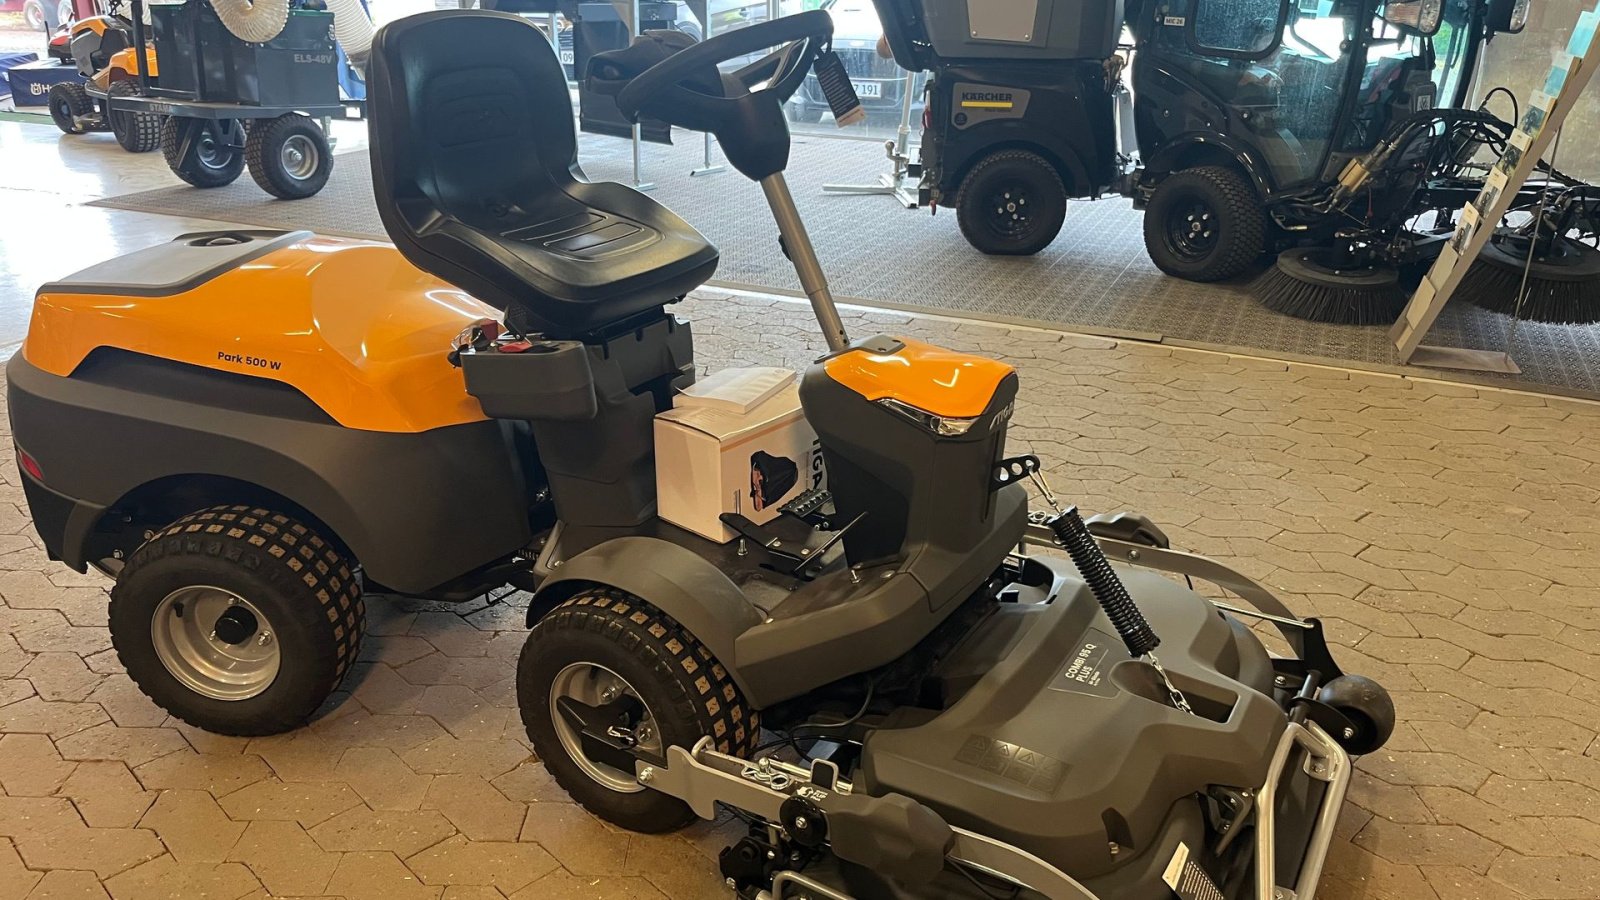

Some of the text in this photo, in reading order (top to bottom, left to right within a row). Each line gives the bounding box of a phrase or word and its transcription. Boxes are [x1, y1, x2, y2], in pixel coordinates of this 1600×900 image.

[294, 54, 332, 64] ELS-48V
[862, 85, 878, 95] 191
[962, 92, 1012, 101] KÄRCHER
[218, 351, 281, 370] Park 500 W
[1065, 656, 1087, 679] COMBI
[1079, 648, 1091, 658] 95
[1075, 665, 1093, 683] PLUS
